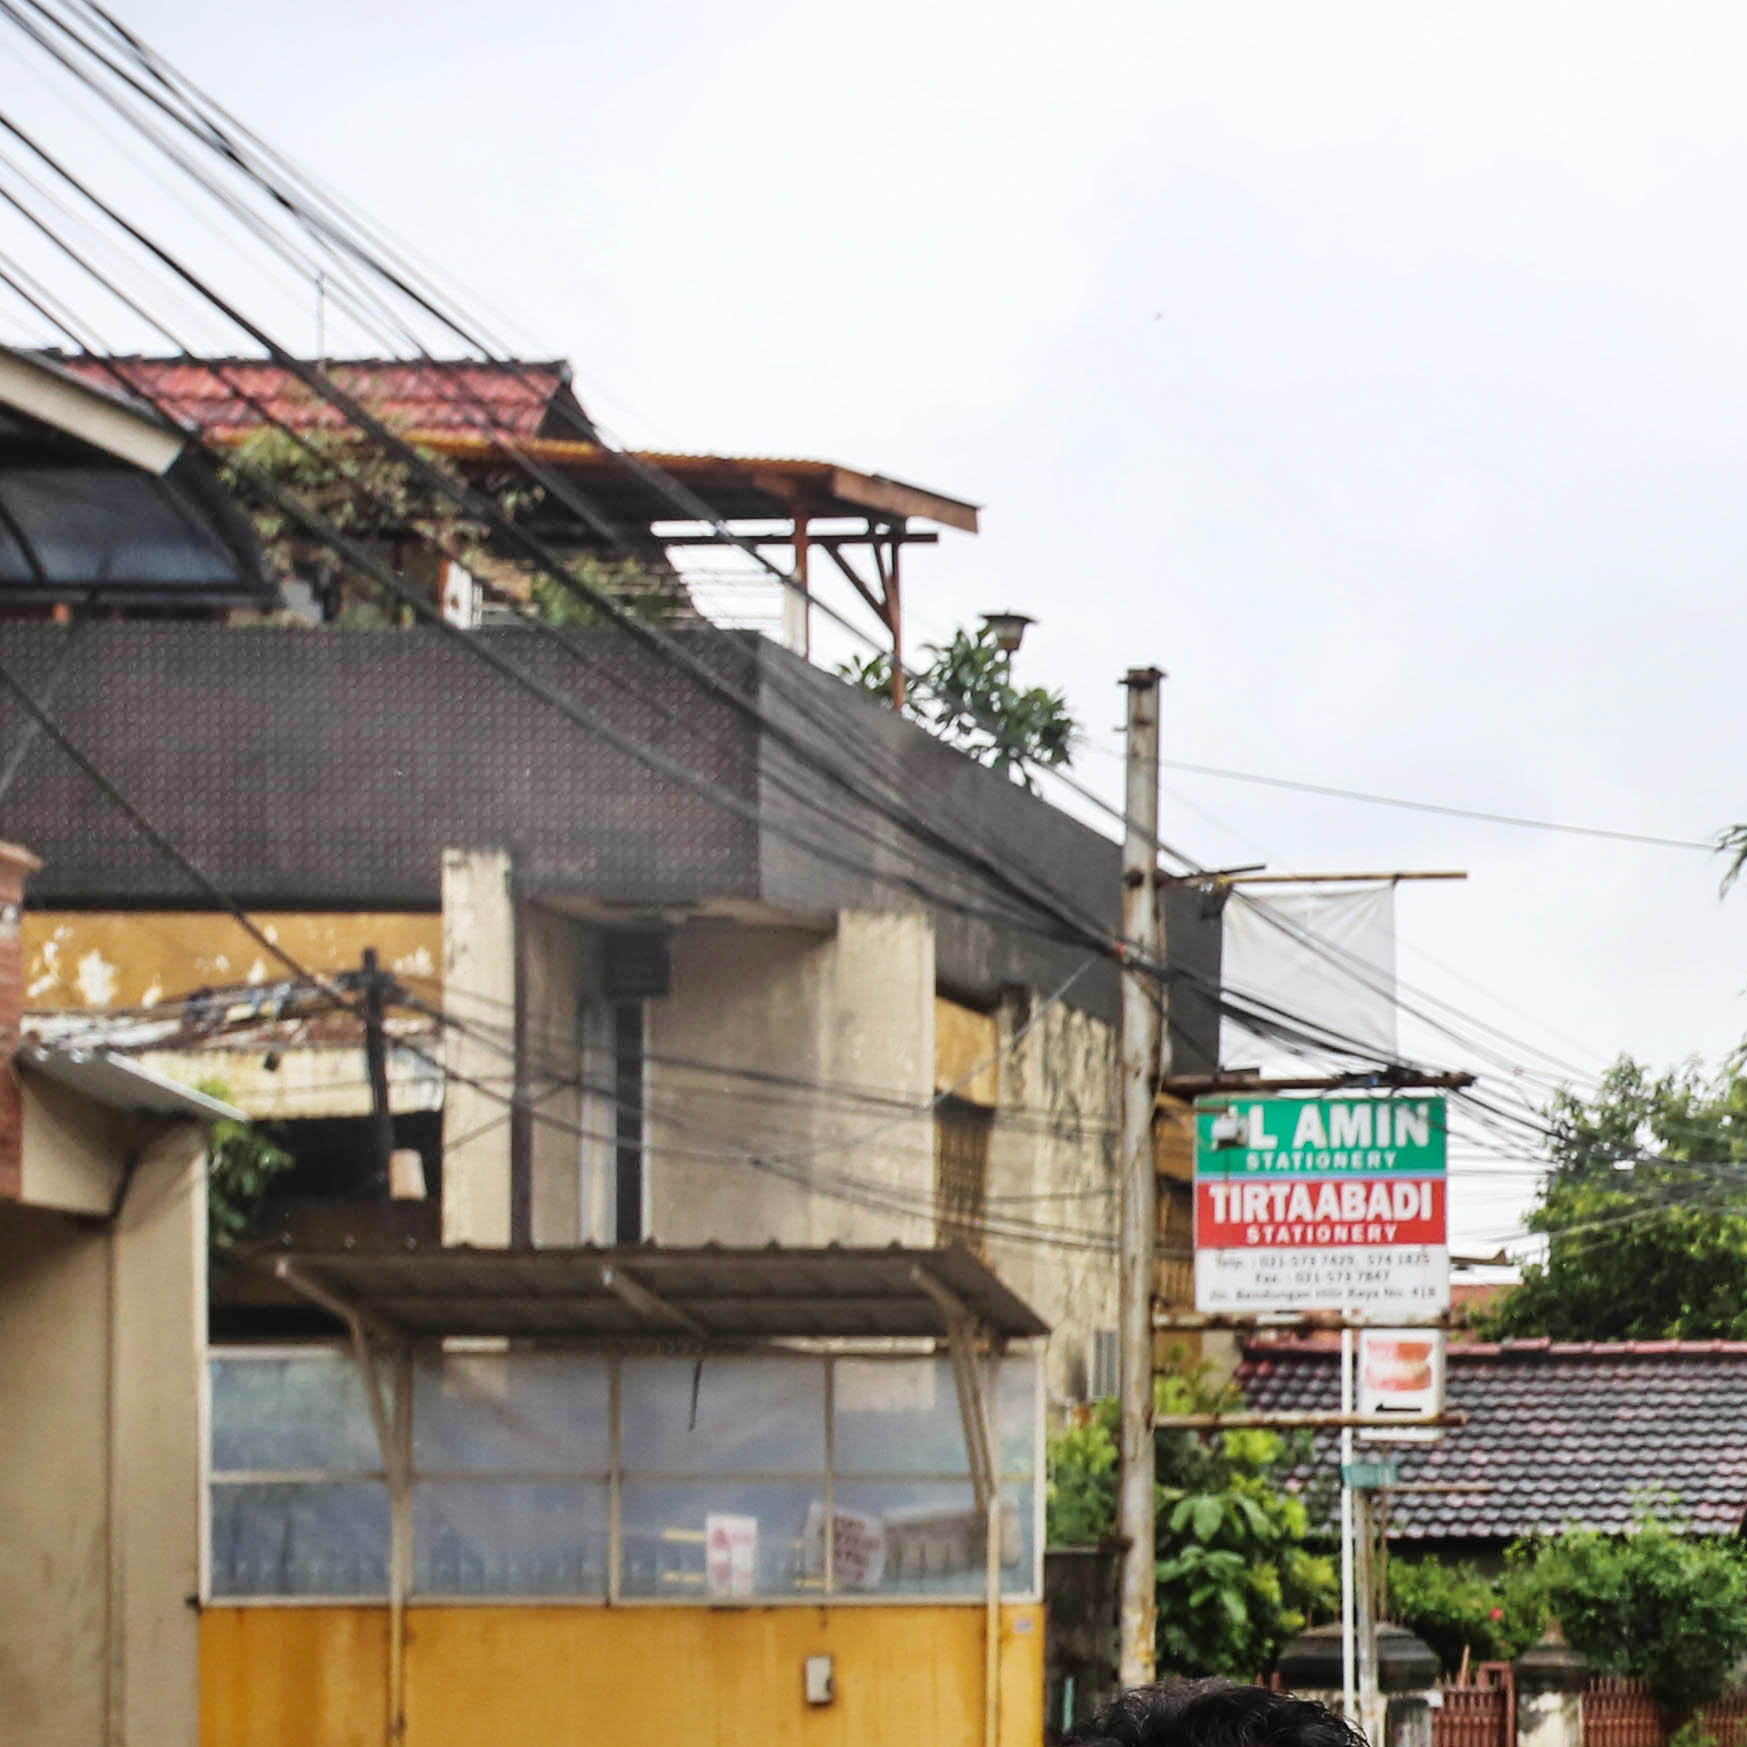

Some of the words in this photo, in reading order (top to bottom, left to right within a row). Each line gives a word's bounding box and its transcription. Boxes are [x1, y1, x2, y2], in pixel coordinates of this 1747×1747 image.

[1292, 1103, 1429, 1149] AMIN
[1246, 1151, 1397, 1171] STATIONERY
[1209, 1181, 1433, 1224] TIRTAABADI
[1246, 1224, 1398, 1244] STATIONERY
